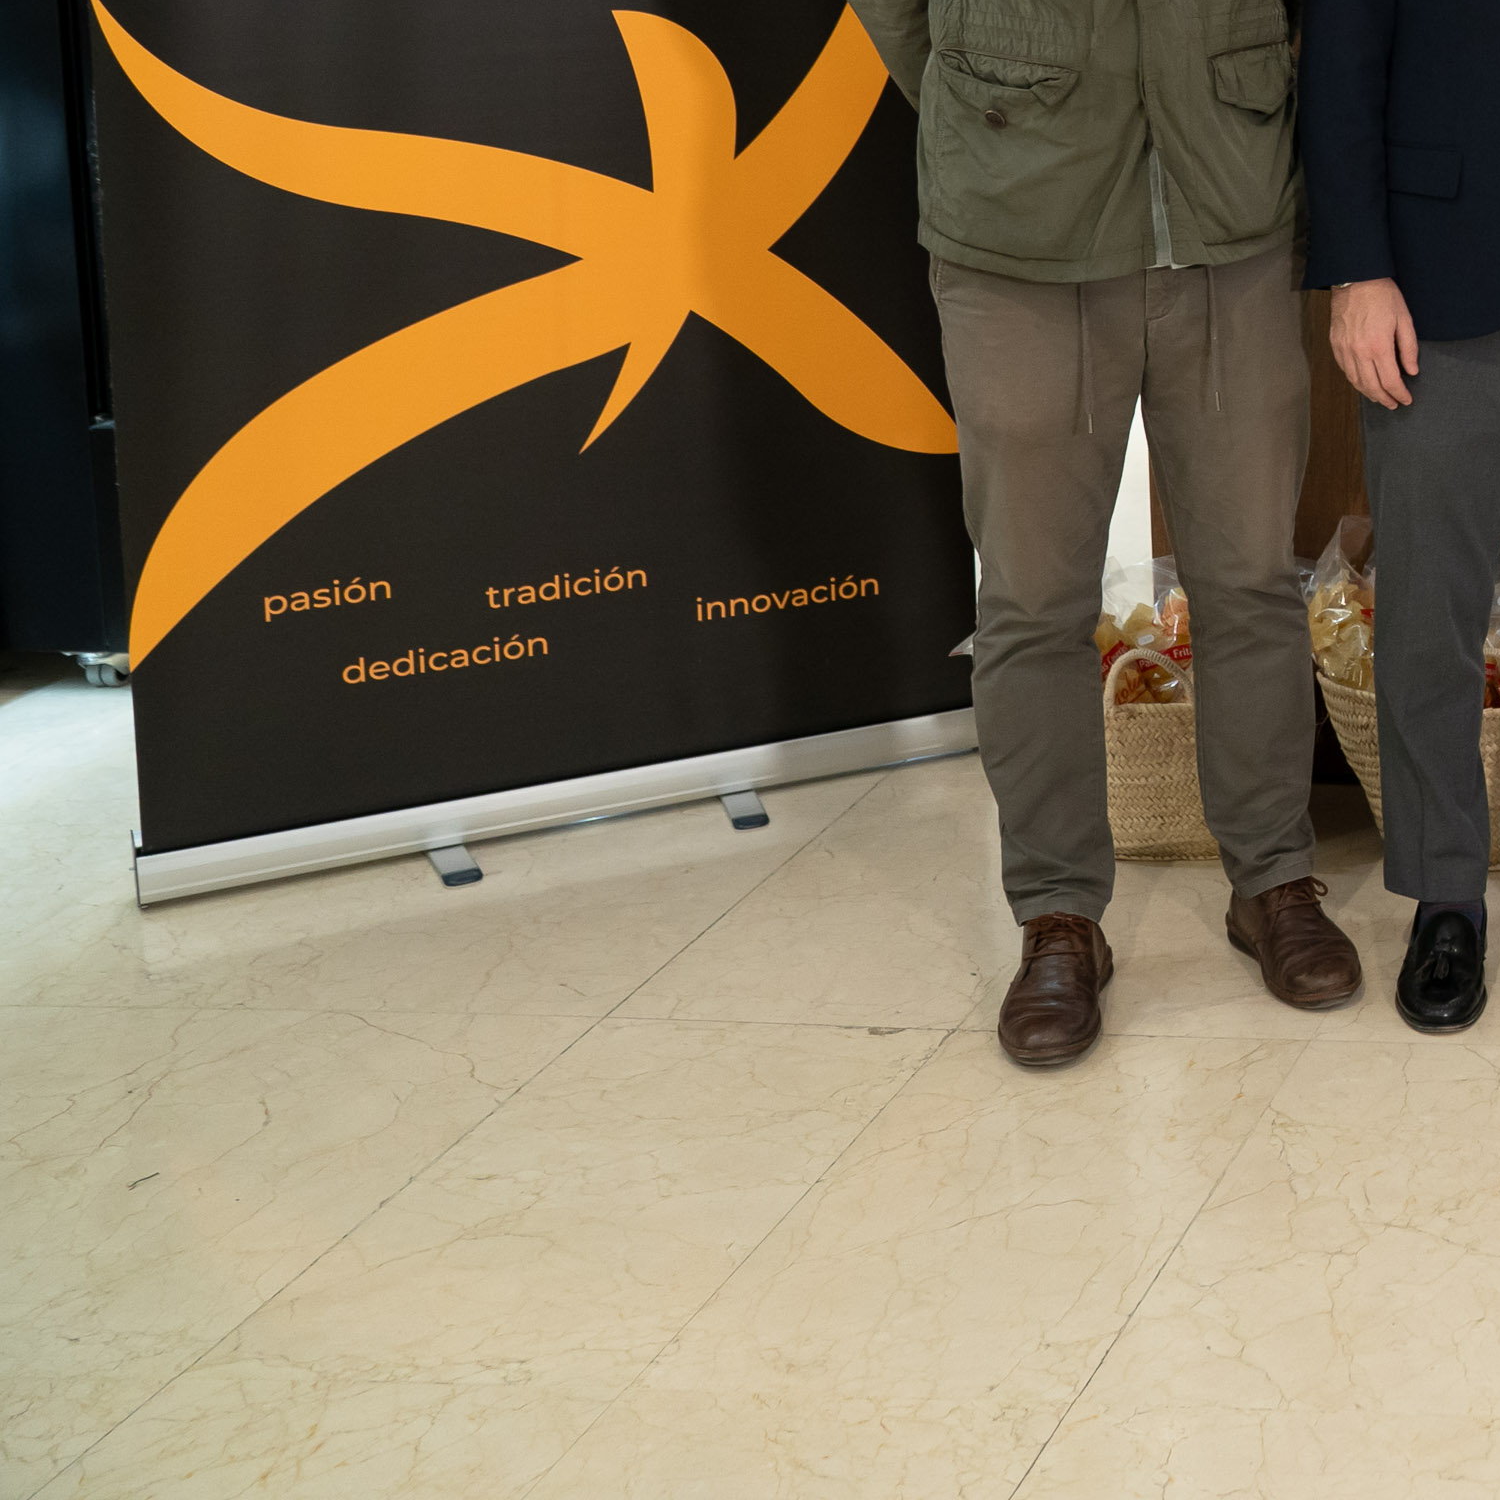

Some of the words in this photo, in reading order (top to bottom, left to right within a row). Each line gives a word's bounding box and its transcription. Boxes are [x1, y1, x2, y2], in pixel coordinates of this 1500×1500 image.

[263, 576, 392, 623] pasión
[484, 565, 648, 610] tradición
[695, 574, 881, 622] innovación
[341, 634, 550, 686] dedicación
